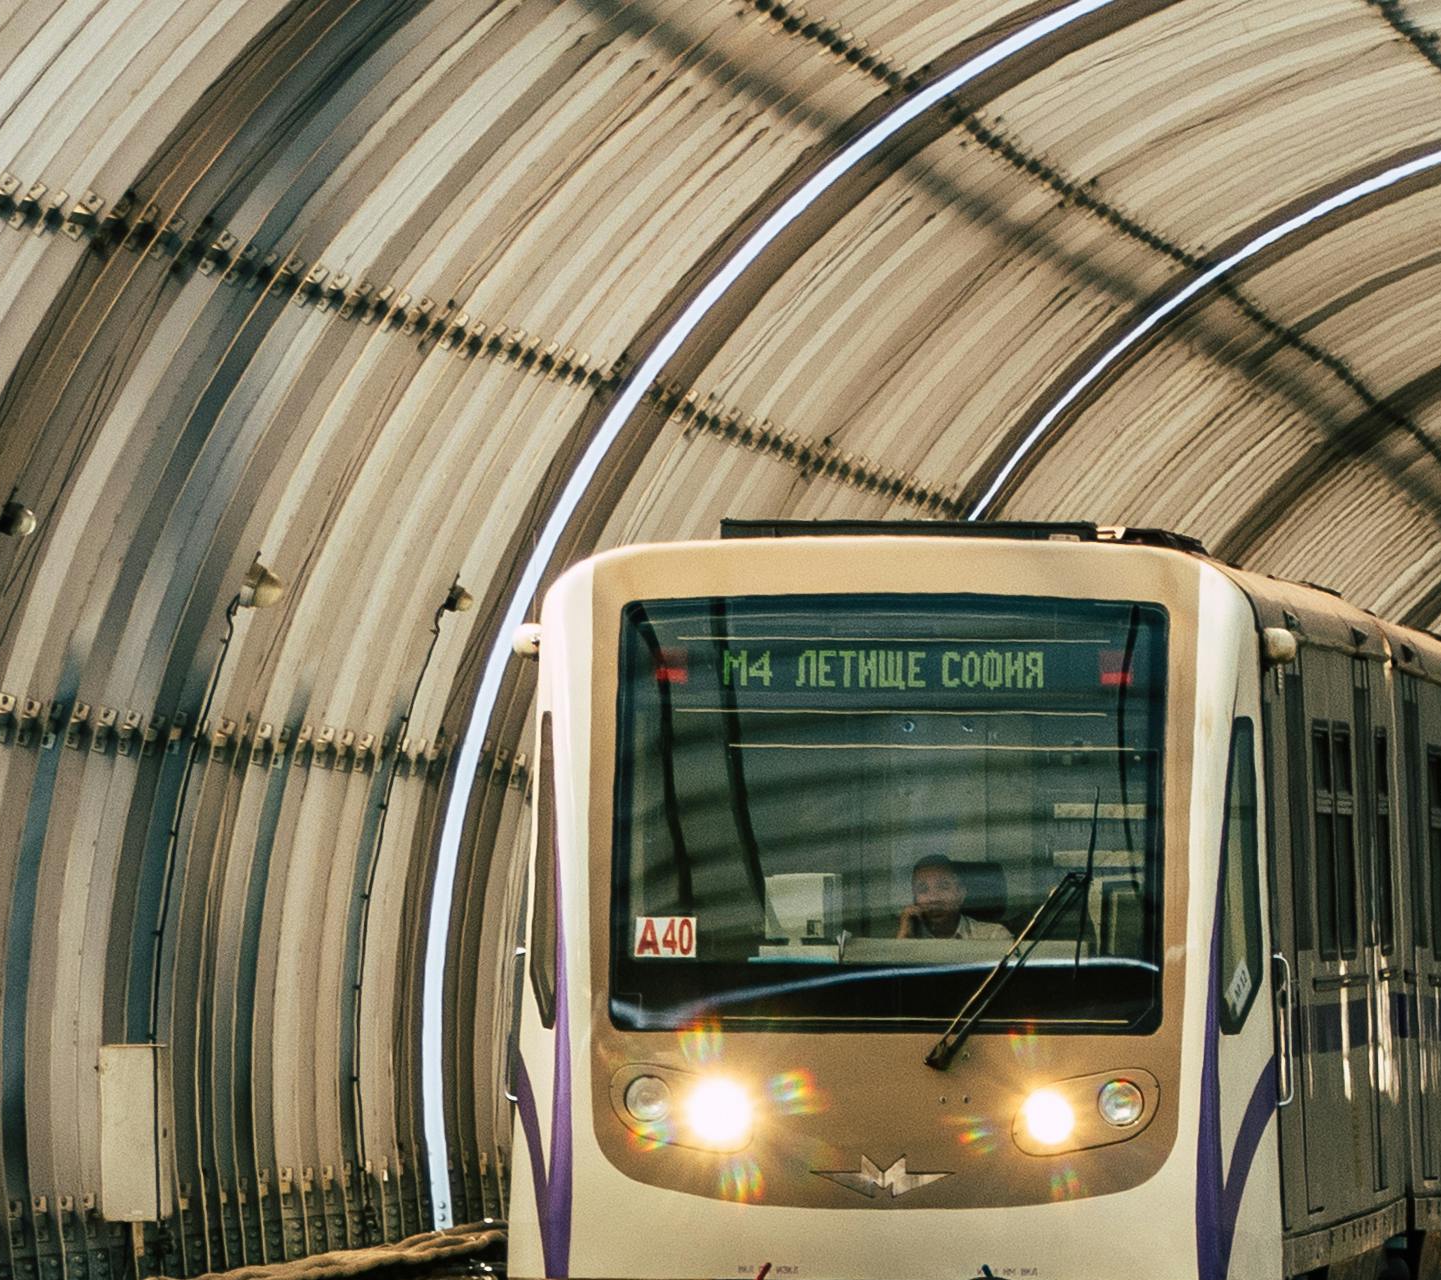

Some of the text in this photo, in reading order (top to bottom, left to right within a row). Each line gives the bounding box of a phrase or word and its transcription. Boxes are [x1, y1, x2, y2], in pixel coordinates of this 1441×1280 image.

[795, 650, 927, 690] ЛЕТИЩЕ
[941, 650, 1046, 689] СОФИЯ
[636, 918, 693, 956] A40
